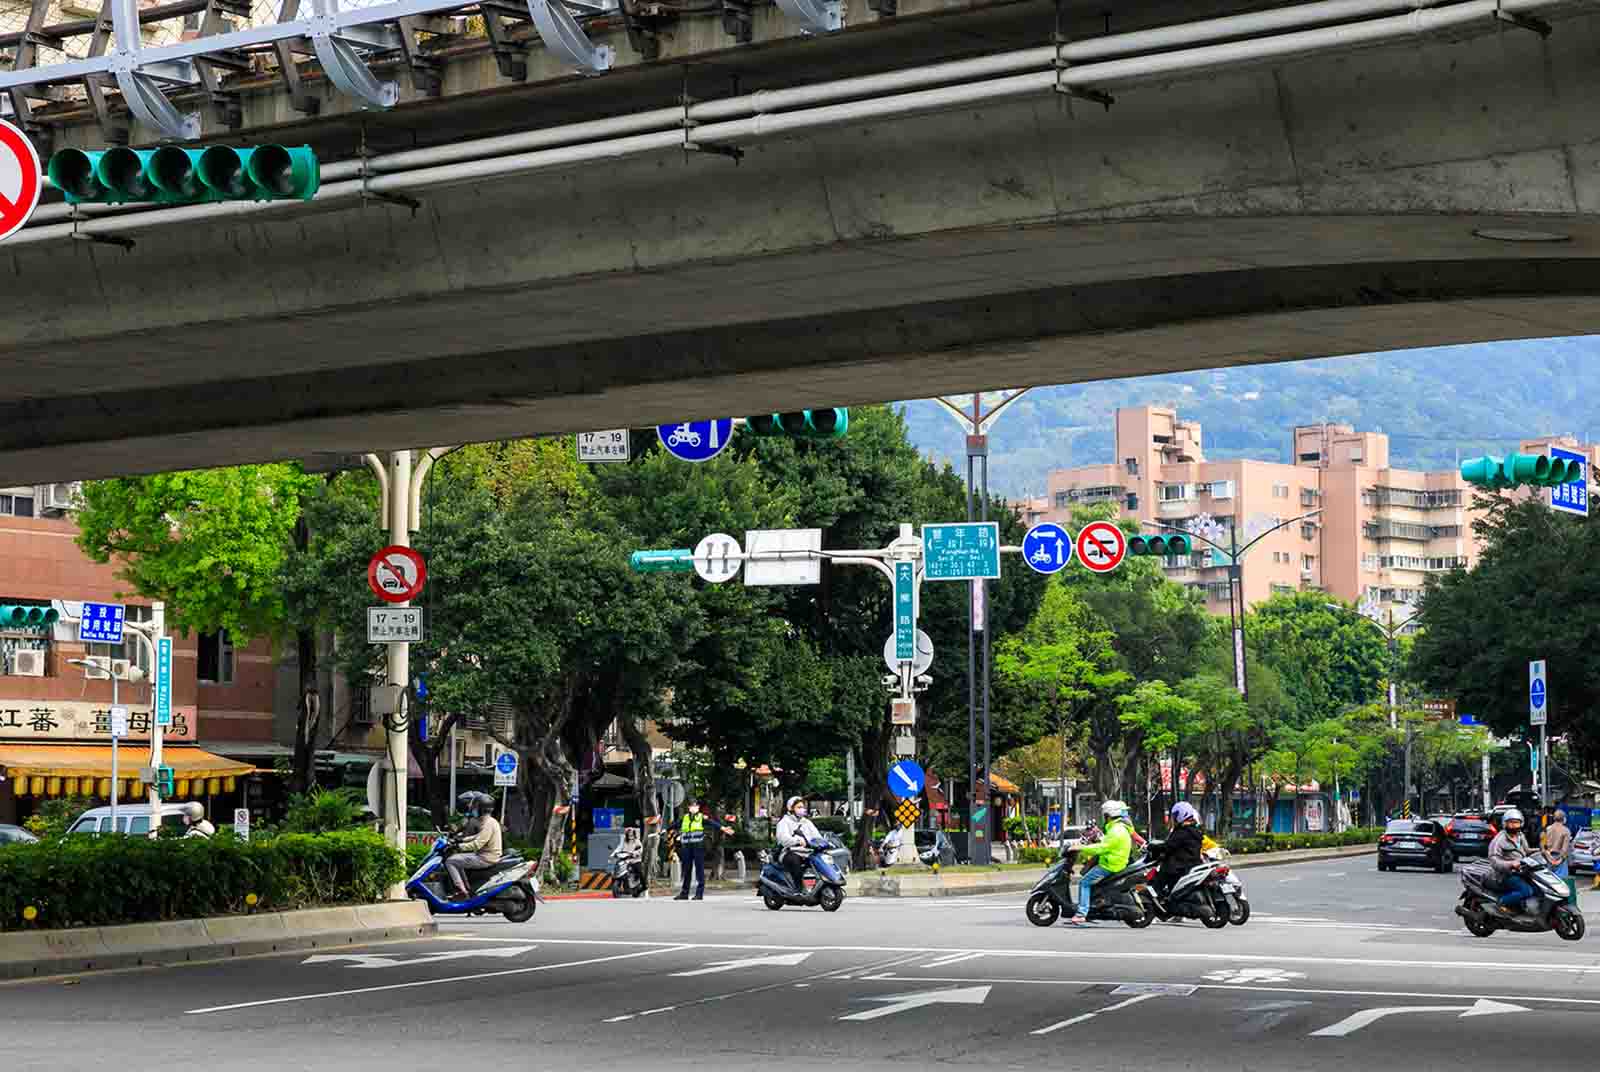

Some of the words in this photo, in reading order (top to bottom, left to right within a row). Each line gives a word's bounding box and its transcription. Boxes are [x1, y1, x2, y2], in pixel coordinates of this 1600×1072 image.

[584, 433, 594, 442] 17
[611, 432, 622, 442] 19
[376, 614, 387, 623] 17
[403, 614, 415, 623] 19
